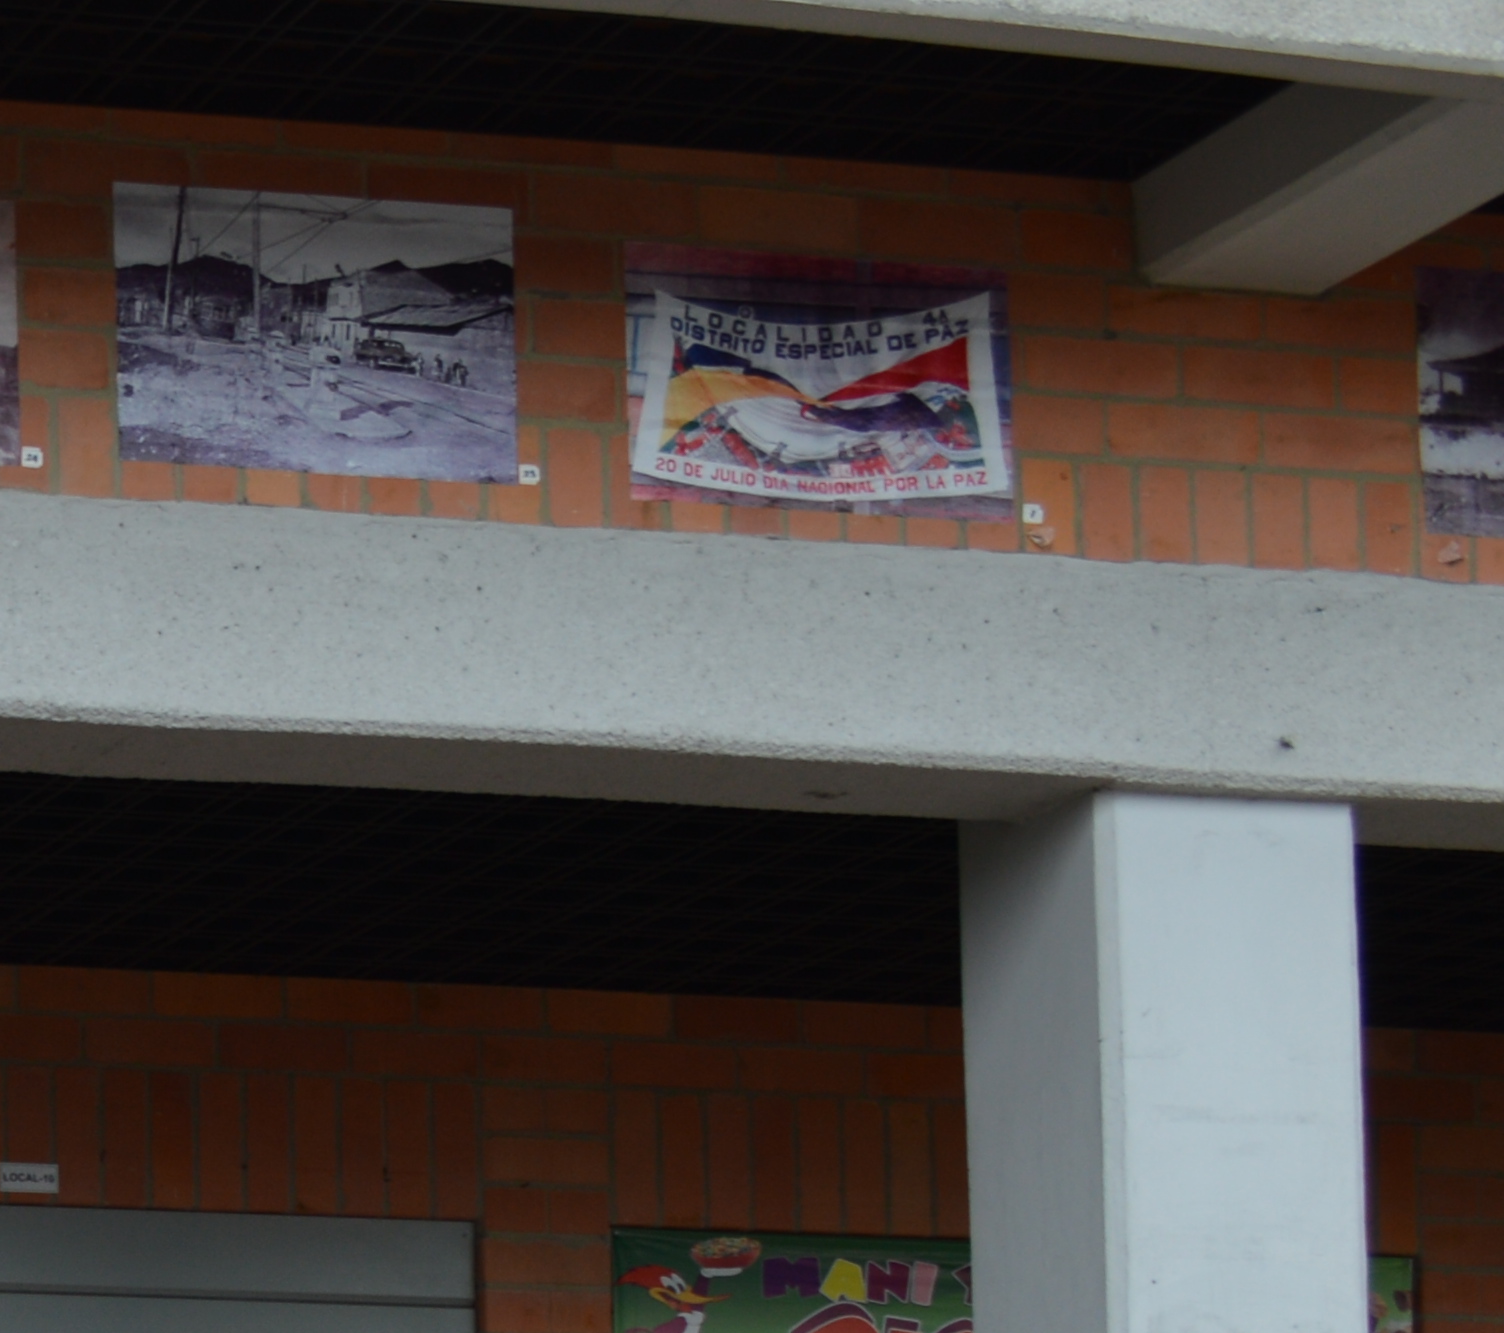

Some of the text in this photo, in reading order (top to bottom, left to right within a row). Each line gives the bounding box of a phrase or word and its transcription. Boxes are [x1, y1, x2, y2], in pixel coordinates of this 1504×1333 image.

[670, 316, 766, 354] DISTRITO
[775, 338, 879, 360] ESPECIAL
[887, 334, 914, 352] DE
[683, 304, 883, 343] LOCALIDAD
[655, 454, 677, 473] 20
[684, 463, 703, 479] DE
[711, 466, 757, 487] JULIO
[883, 477, 919, 492] POR
[925, 476, 946, 490] LA
[954, 471, 988, 487] PAZ
[760, 1255, 939, 1306] MANI
